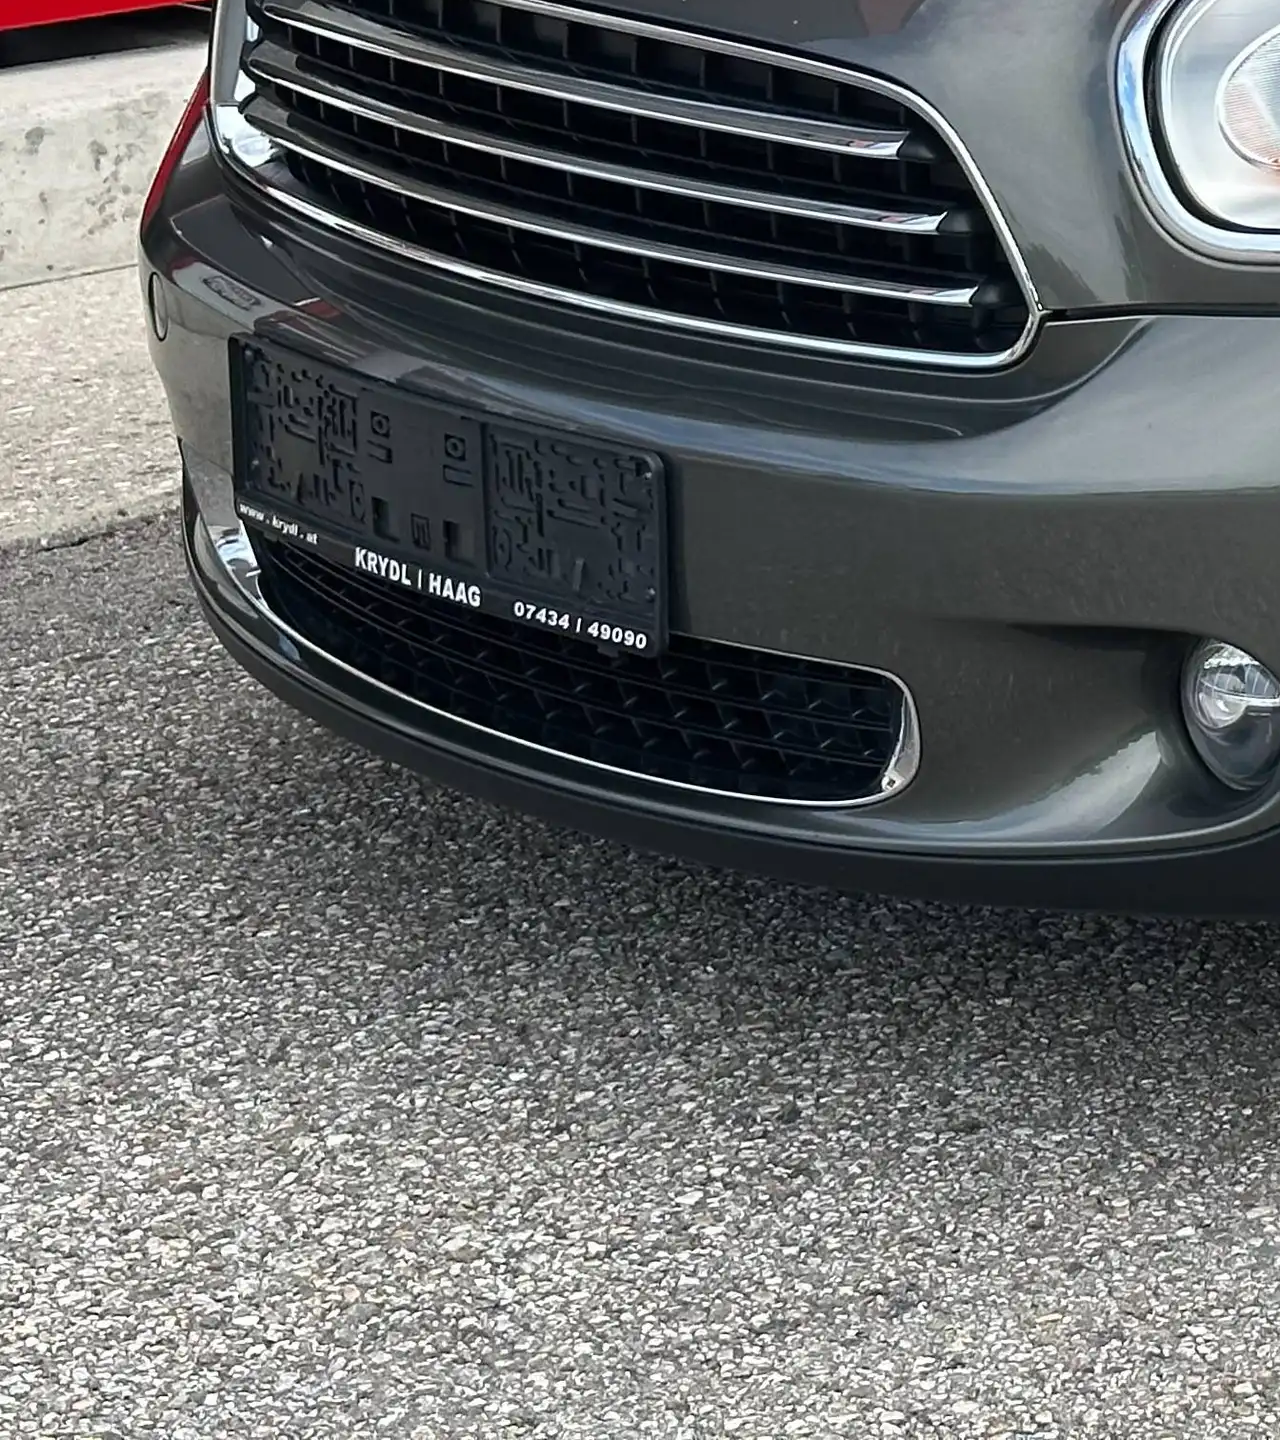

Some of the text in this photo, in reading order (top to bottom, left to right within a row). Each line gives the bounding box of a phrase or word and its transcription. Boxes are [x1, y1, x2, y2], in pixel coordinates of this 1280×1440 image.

[354, 546, 482, 609] KRYDL HAAG
[513, 601, 648, 649] 07434 49090
